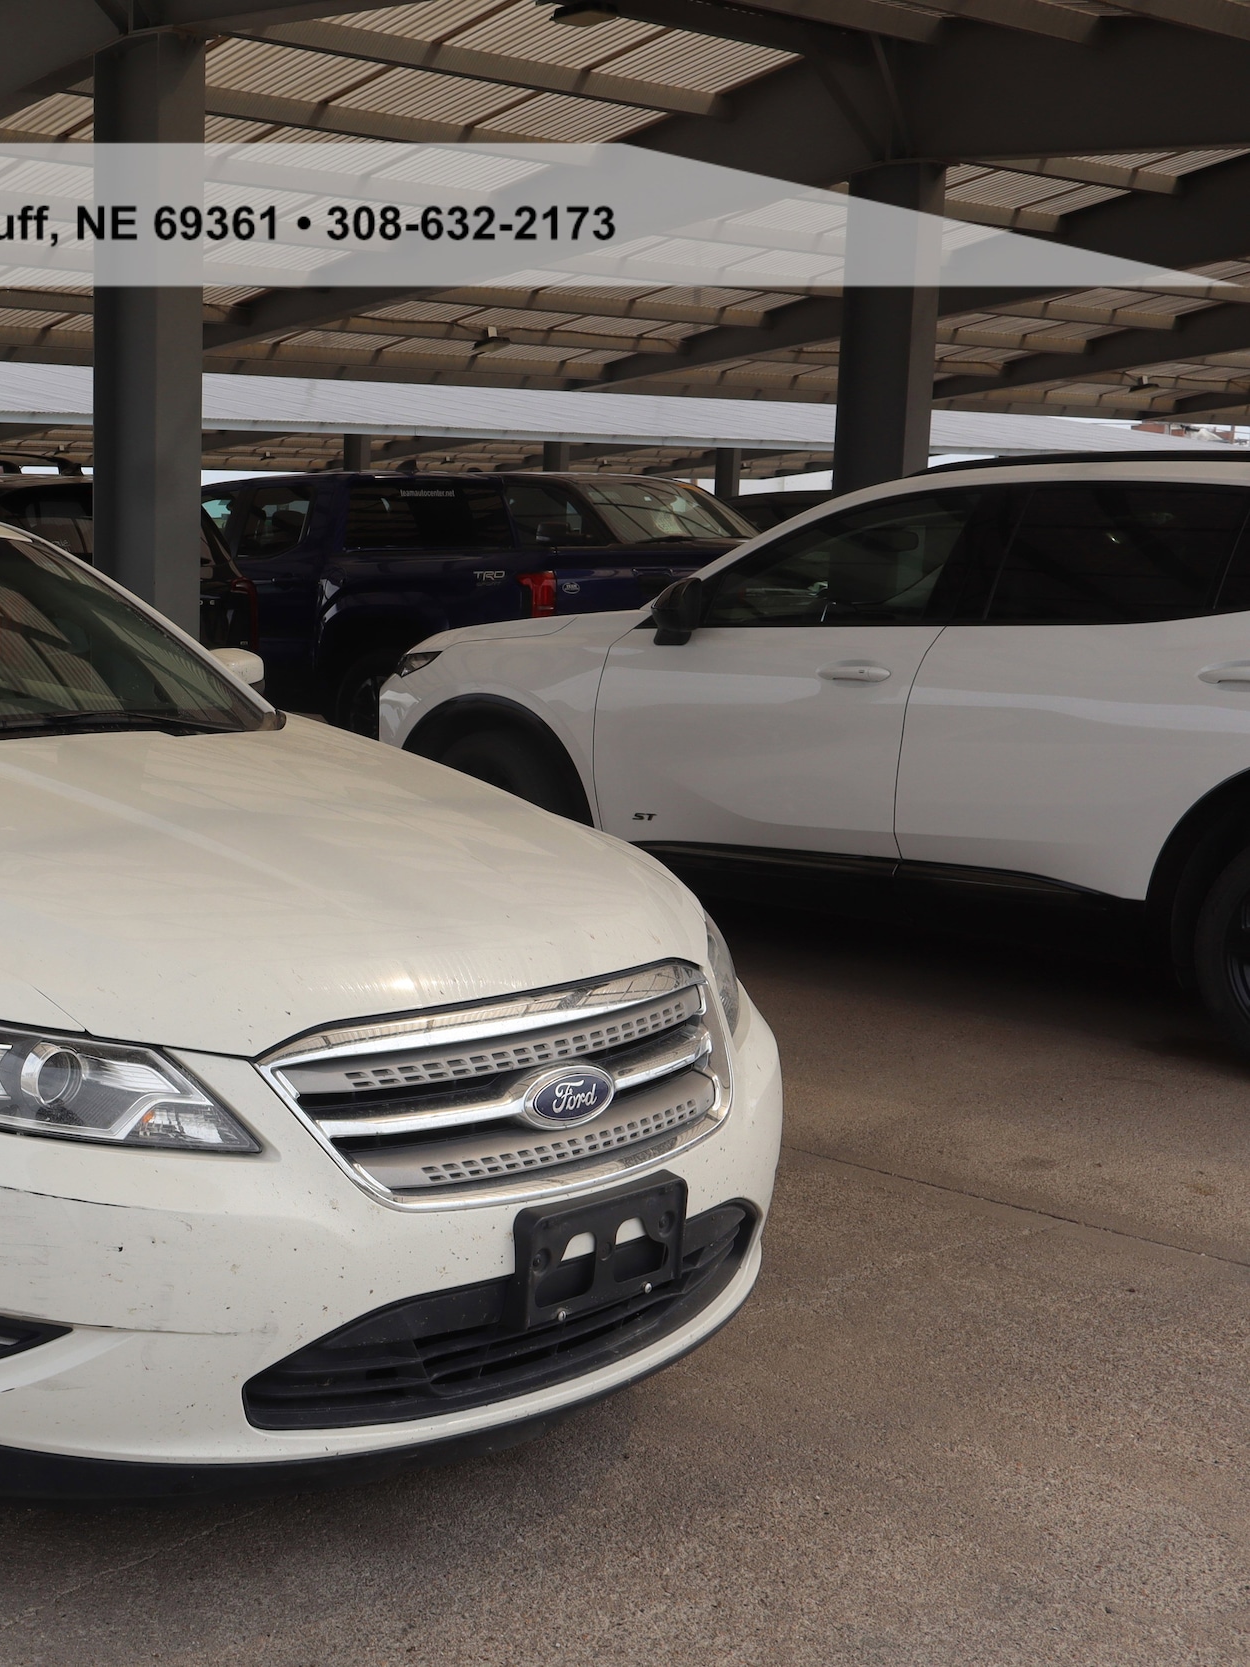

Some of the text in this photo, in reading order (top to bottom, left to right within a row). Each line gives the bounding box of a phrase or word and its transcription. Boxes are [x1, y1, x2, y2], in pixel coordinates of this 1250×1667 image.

[399, 488, 456, 498] teamautocenter.net
[472, 570, 506, 581] TRD
[632, 812, 658, 821] ST
[552, 1079, 598, 1114] Ford
